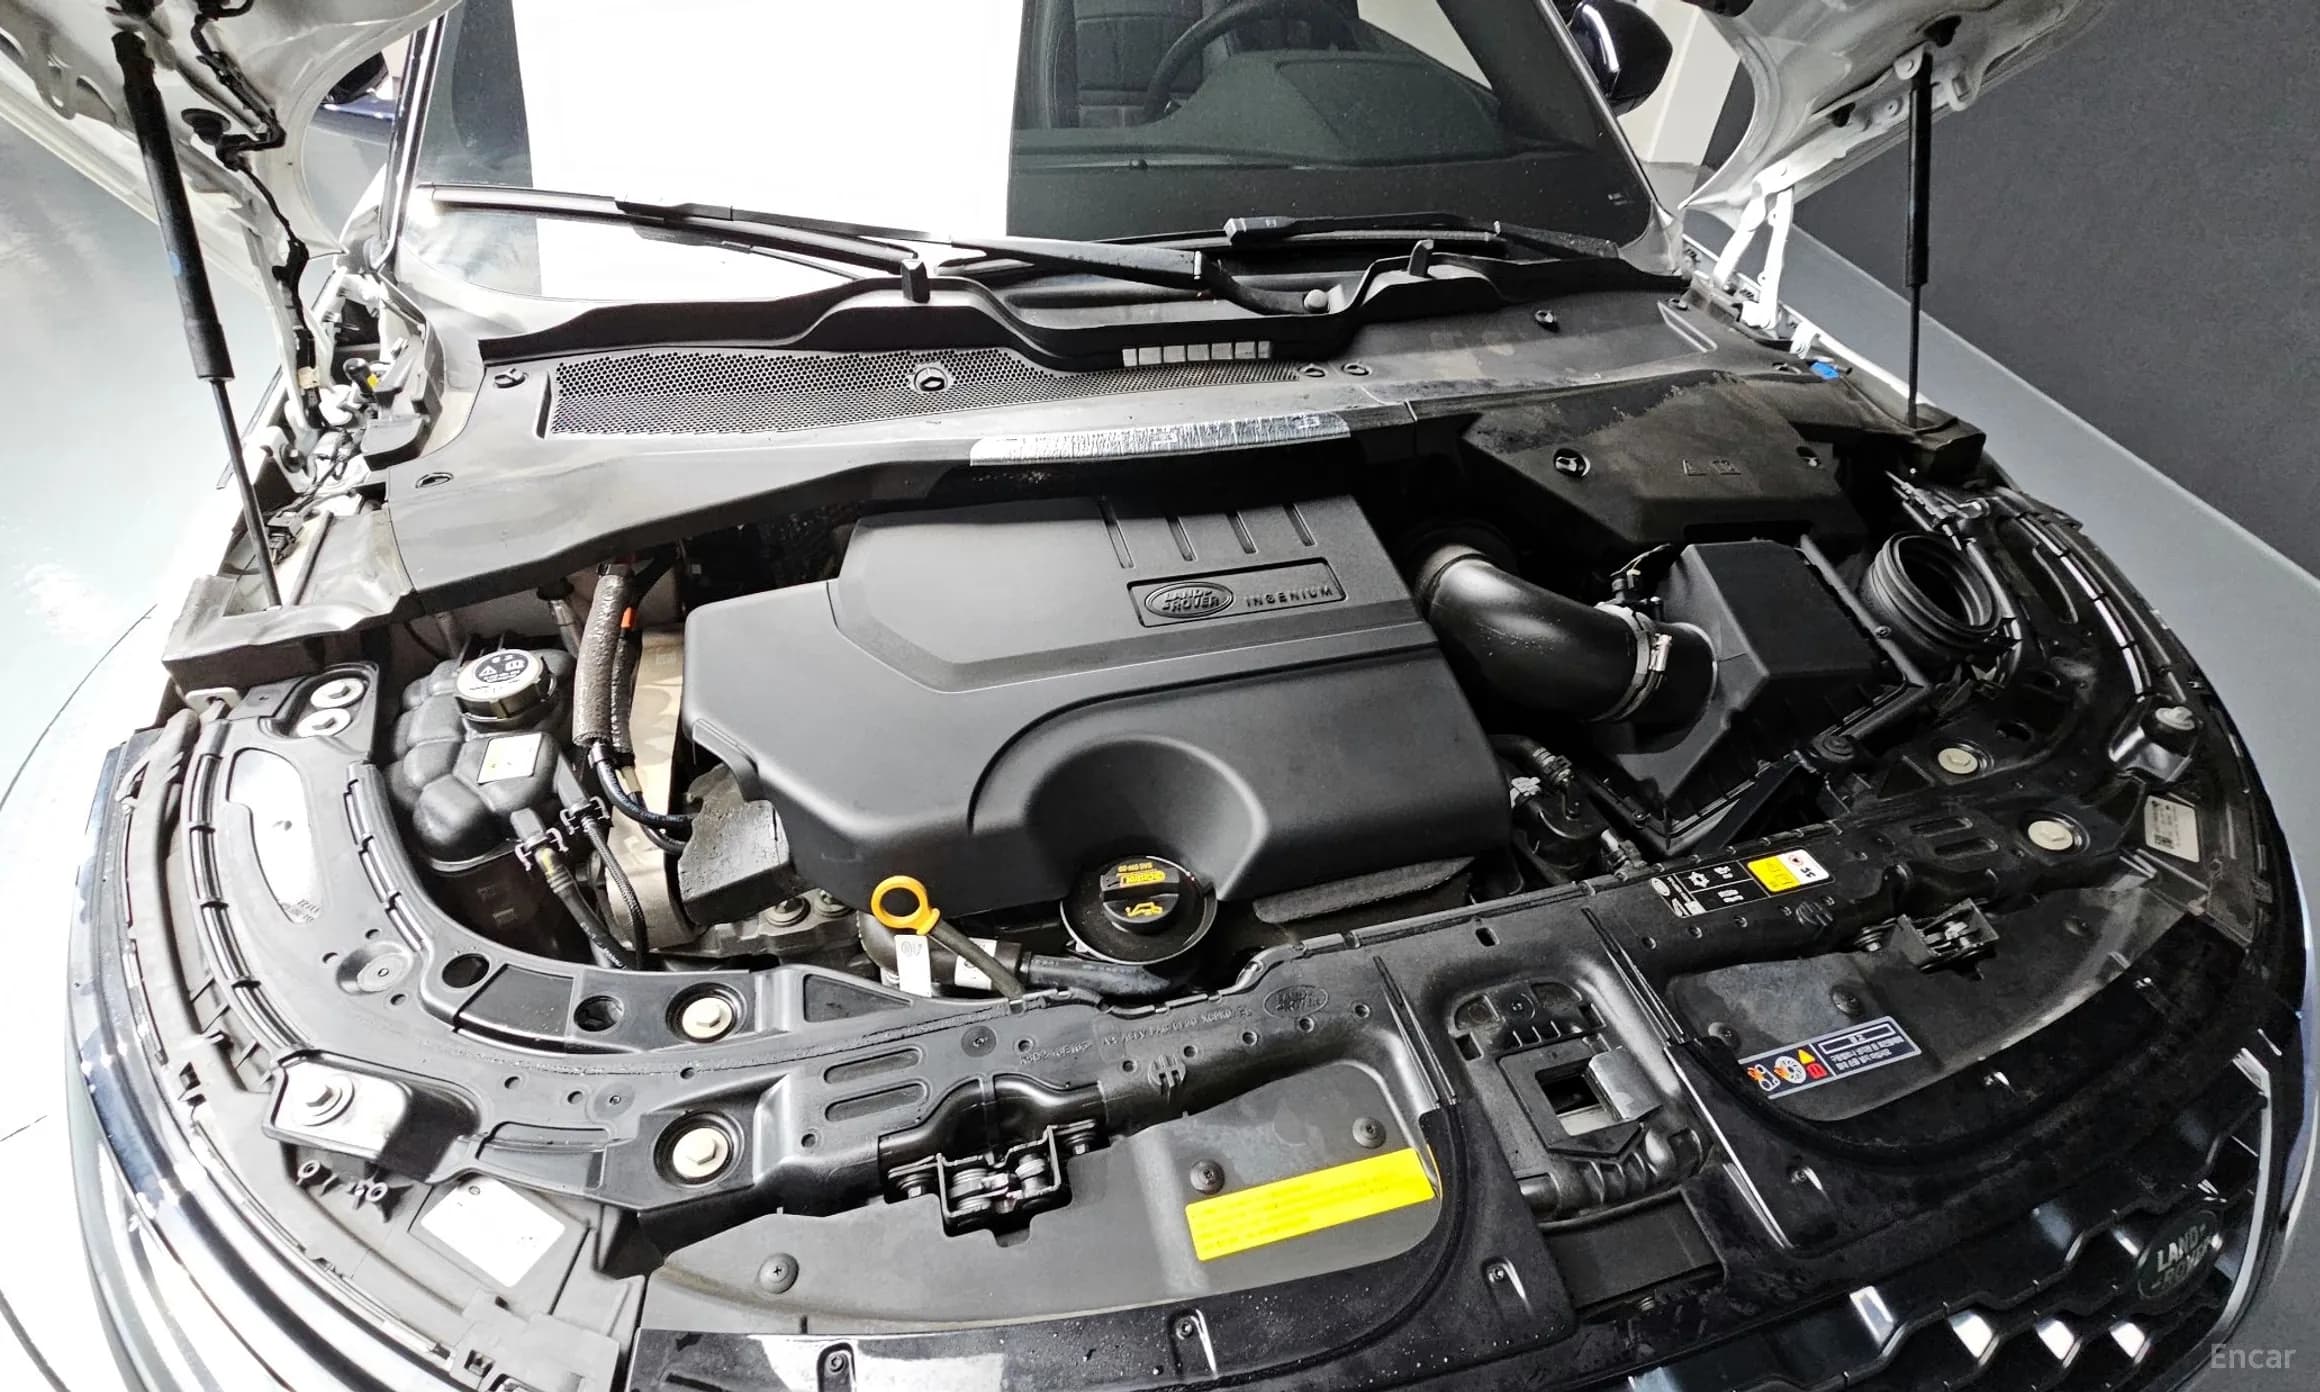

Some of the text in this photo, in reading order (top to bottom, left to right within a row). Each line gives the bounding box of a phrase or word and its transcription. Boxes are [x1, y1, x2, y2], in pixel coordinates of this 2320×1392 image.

[1171, 596, 1220, 613] ROVER
[1243, 585, 1333, 608] INGENIUM
[2157, 1225, 2199, 1273] LAND
